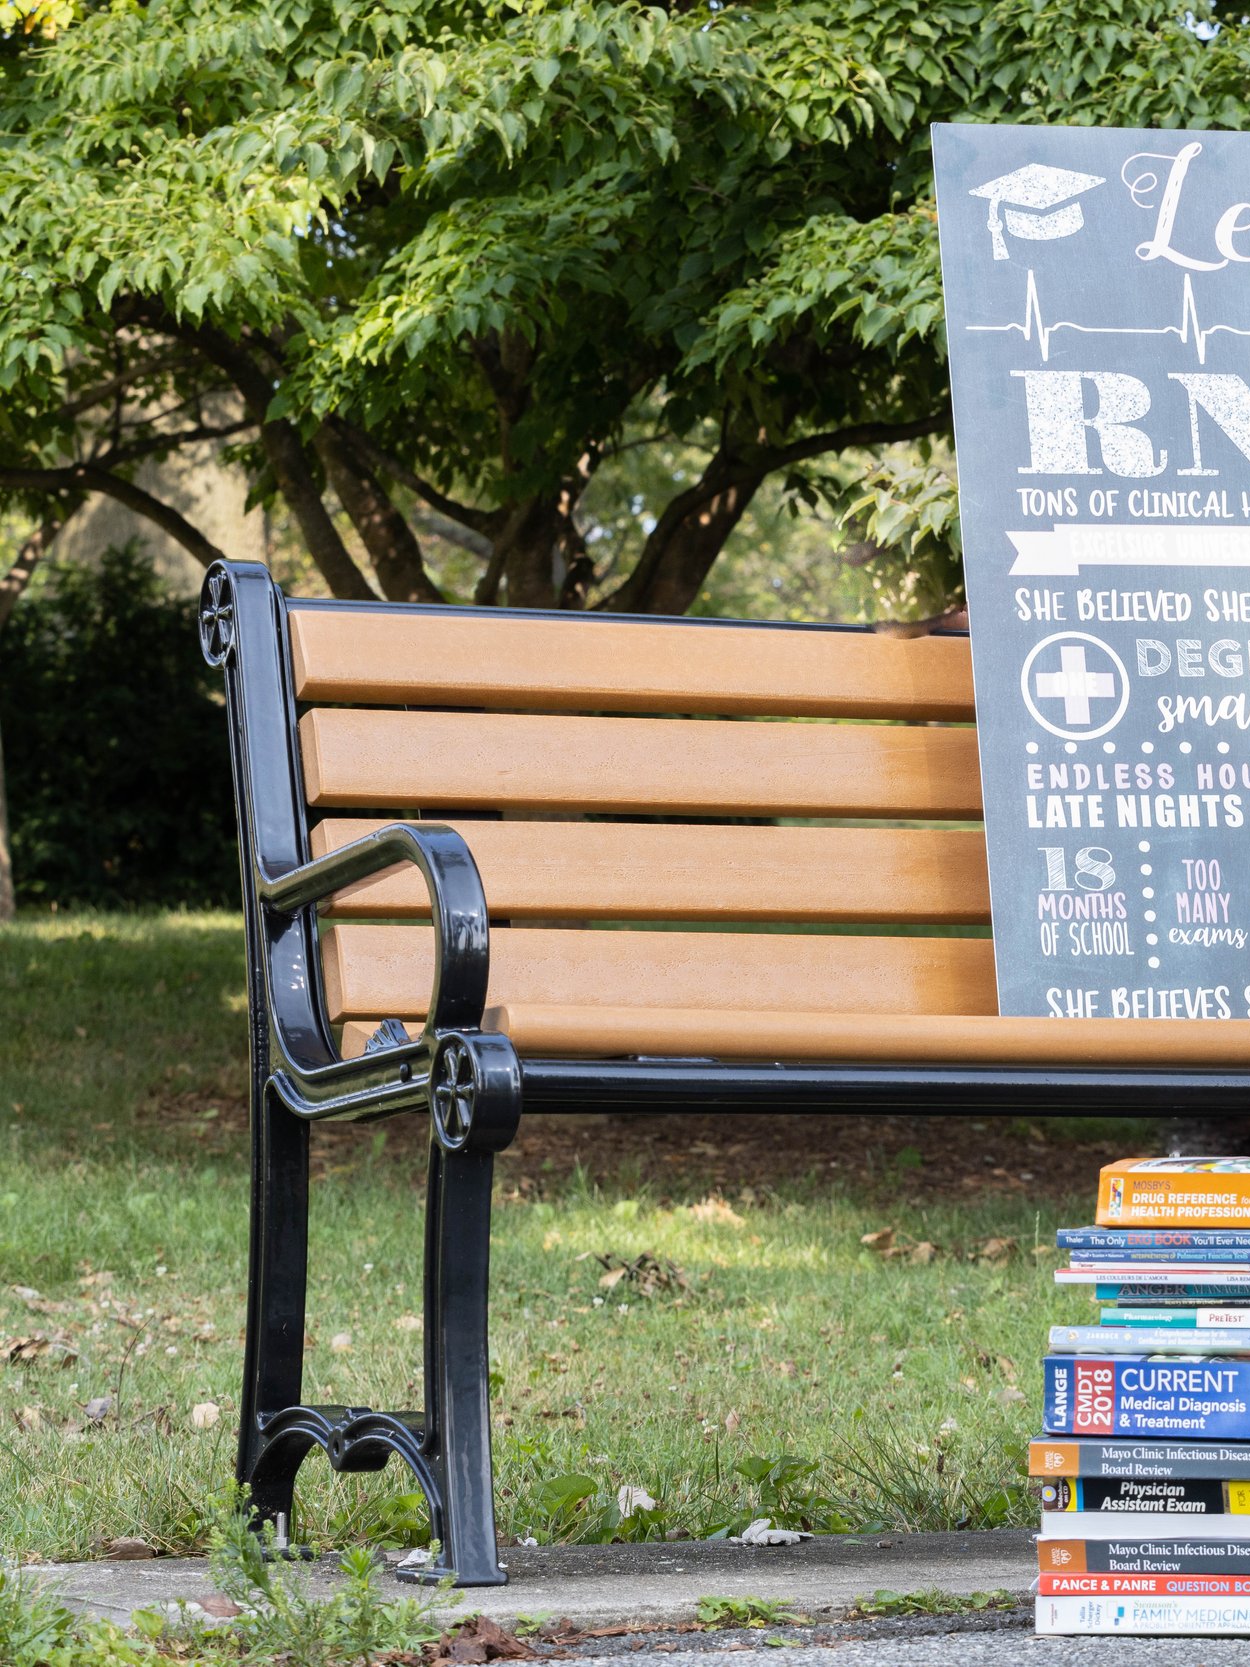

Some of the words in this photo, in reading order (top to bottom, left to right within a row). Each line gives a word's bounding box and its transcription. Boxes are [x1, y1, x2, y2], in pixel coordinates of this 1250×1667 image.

[1016, 487, 1079, 517] TONS
[1088, 488, 1119, 516] OF
[1127, 488, 1236, 519] CLINICAL
[1070, 531, 1167, 560] EXCELSIOR
[1015, 588, 1064, 622] SHE
[1077, 589, 1192, 623] BELIEVED
[1027, 763, 1176, 790] ENDLESS
[1026, 795, 1104, 829] LATE
[1116, 795, 1244, 828] NIGHTS
[1037, 847, 1116, 891] 18
[1181, 859, 1221, 890] TOO
[1037, 891, 1127, 921] MONTHS
[1176, 892, 1231, 924] MANY
[1040, 922, 1060, 957] OF
[1069, 921, 1135, 956] SCHOOL
[1168, 925, 1249, 949] exams
[1046, 987, 1099, 1018] SHE
[1111, 985, 1232, 1020] BELIEVES
[1132, 1180, 1171, 1191] MOSBY'S
[1131, 1193, 1164, 1205] DRUG
[1168, 1193, 1238, 1205] REFERENCE
[1130, 1206, 1174, 1217] HEALTH
[1090, 1236, 1106, 1245] The
[1106, 1236, 1126, 1248] Only
[1127, 1233, 1152, 1245] EKG
[1155, 1233, 1191, 1245] BOOK
[1192, 1236, 1214, 1246] You'll
[1216, 1236, 1234, 1246] Ever
[1119, 1283, 1188, 1296] ANGER
[1123, 1313, 1173, 1323] Pharmacology
[1120, 1368, 1239, 1393] CURRENT
[1053, 1368, 1068, 1427] LANGE
[1076, 1366, 1093, 1427] CMDT
[1093, 1368, 1113, 1426] 2018
[1120, 1396, 1175, 1411] Medical
[1178, 1398, 1247, 1415] Diagnosis
[1119, 1414, 1131, 1428] &
[1134, 1414, 1206, 1430] Treatment
[1101, 1447, 1131, 1462] Mayo
[1132, 1447, 1163, 1460] Clinic
[1165, 1448, 1218, 1461] Infectious
[1101, 1463, 1133, 1475] Board
[1134, 1464, 1173, 1476] Review
[1119, 1481, 1186, 1499] Physician
[1100, 1496, 1164, 1512] Assistant
[1166, 1497, 1207, 1514] Exam
[1108, 1543, 1138, 1558] Mayo
[1139, 1544, 1171, 1556] Clinic
[1173, 1543, 1226, 1557] Infectious
[1109, 1559, 1141, 1571] Board
[1142, 1560, 1181, 1572] Review
[1052, 1579, 1098, 1591] PANCE
[1100, 1579, 1110, 1591] &
[1113, 1579, 1156, 1591] PANRE
[1166, 1581, 1230, 1593] QUESTION
[1133, 1609, 1183, 1622] FAMILY
